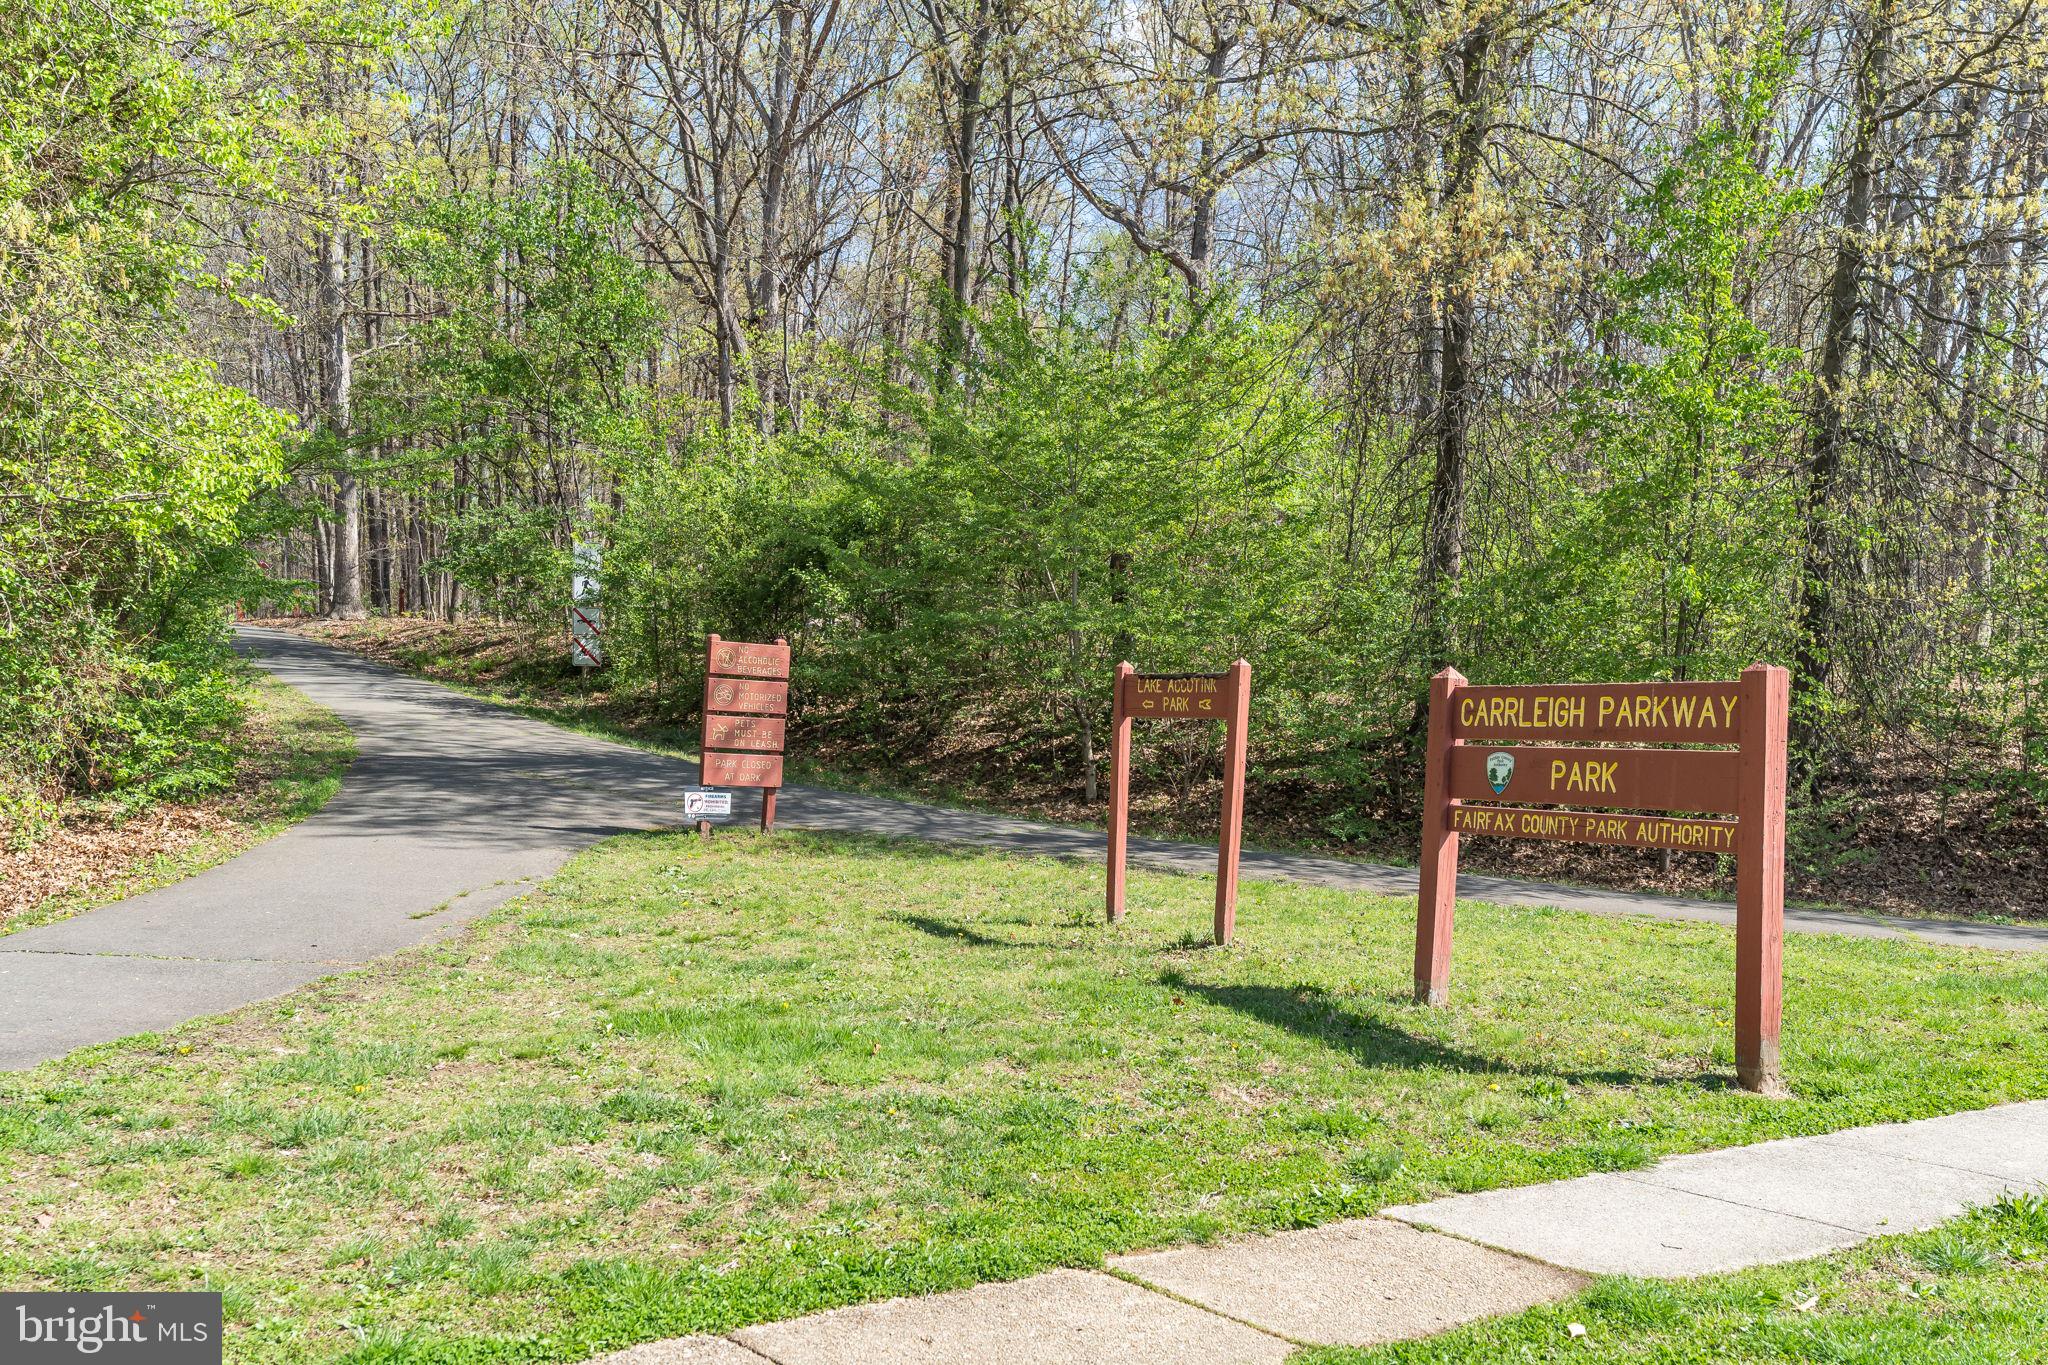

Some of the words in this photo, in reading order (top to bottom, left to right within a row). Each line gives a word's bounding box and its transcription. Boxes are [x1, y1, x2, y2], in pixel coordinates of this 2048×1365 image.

[739, 646, 749, 654] NO
[738, 656, 780, 666] ALCOHOLIC
[737, 665, 782, 676] BEVERAGES
[739, 683, 750, 691] NO
[1137, 678, 1162, 693] LAKE
[1167, 677, 1217, 693] ACCOTINK
[738, 692, 782, 702] MOTORIZED
[738, 702, 774, 712] VEHICLES
[1163, 696, 1189, 712] PARK
[1460, 696, 1585, 728] CARRLEIGH
[1598, 695, 1738, 728] PARKWAY
[735, 719, 756, 728] PETS
[734, 729, 757, 738] MUST
[761, 730, 773, 739] BE
[734, 739, 745, 747] ON
[750, 740, 778, 749] LEASH
[715, 758, 737, 769] PARK
[741, 759, 772, 770] CLOSED
[724, 771, 735, 781] AT
[739, 772, 761, 782] DARK
[1550, 759, 1618, 794] PARK
[1454, 808, 1515, 832] FAIRFAX
[1521, 813, 1579, 837] COUNTY
[1585, 818, 1627, 841] PARK
[1636, 821, 1735, 849] AUTHORITY
